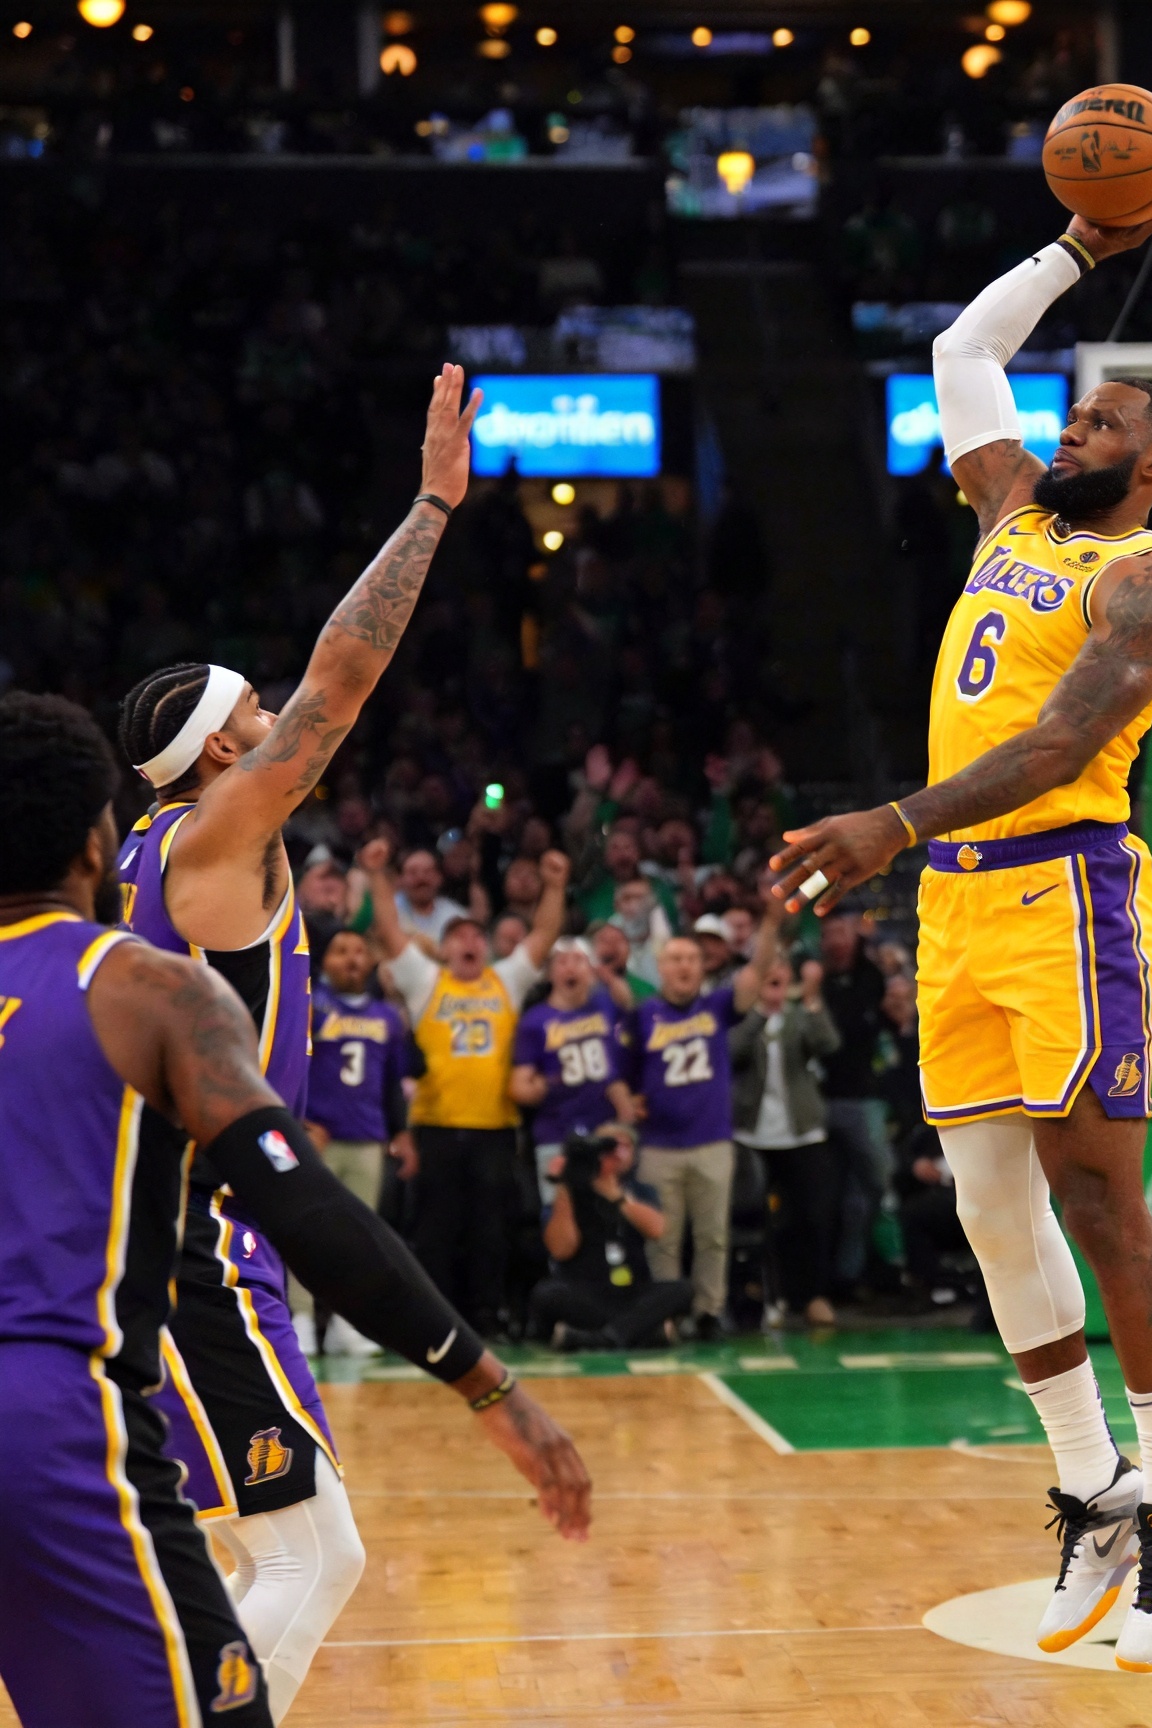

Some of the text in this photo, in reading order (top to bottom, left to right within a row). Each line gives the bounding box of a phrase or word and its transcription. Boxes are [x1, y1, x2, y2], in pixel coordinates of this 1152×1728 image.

[956, 610, 1007, 704] 6
[339, 1040, 366, 1087] 3
[661, 1036, 714, 1087] 22
